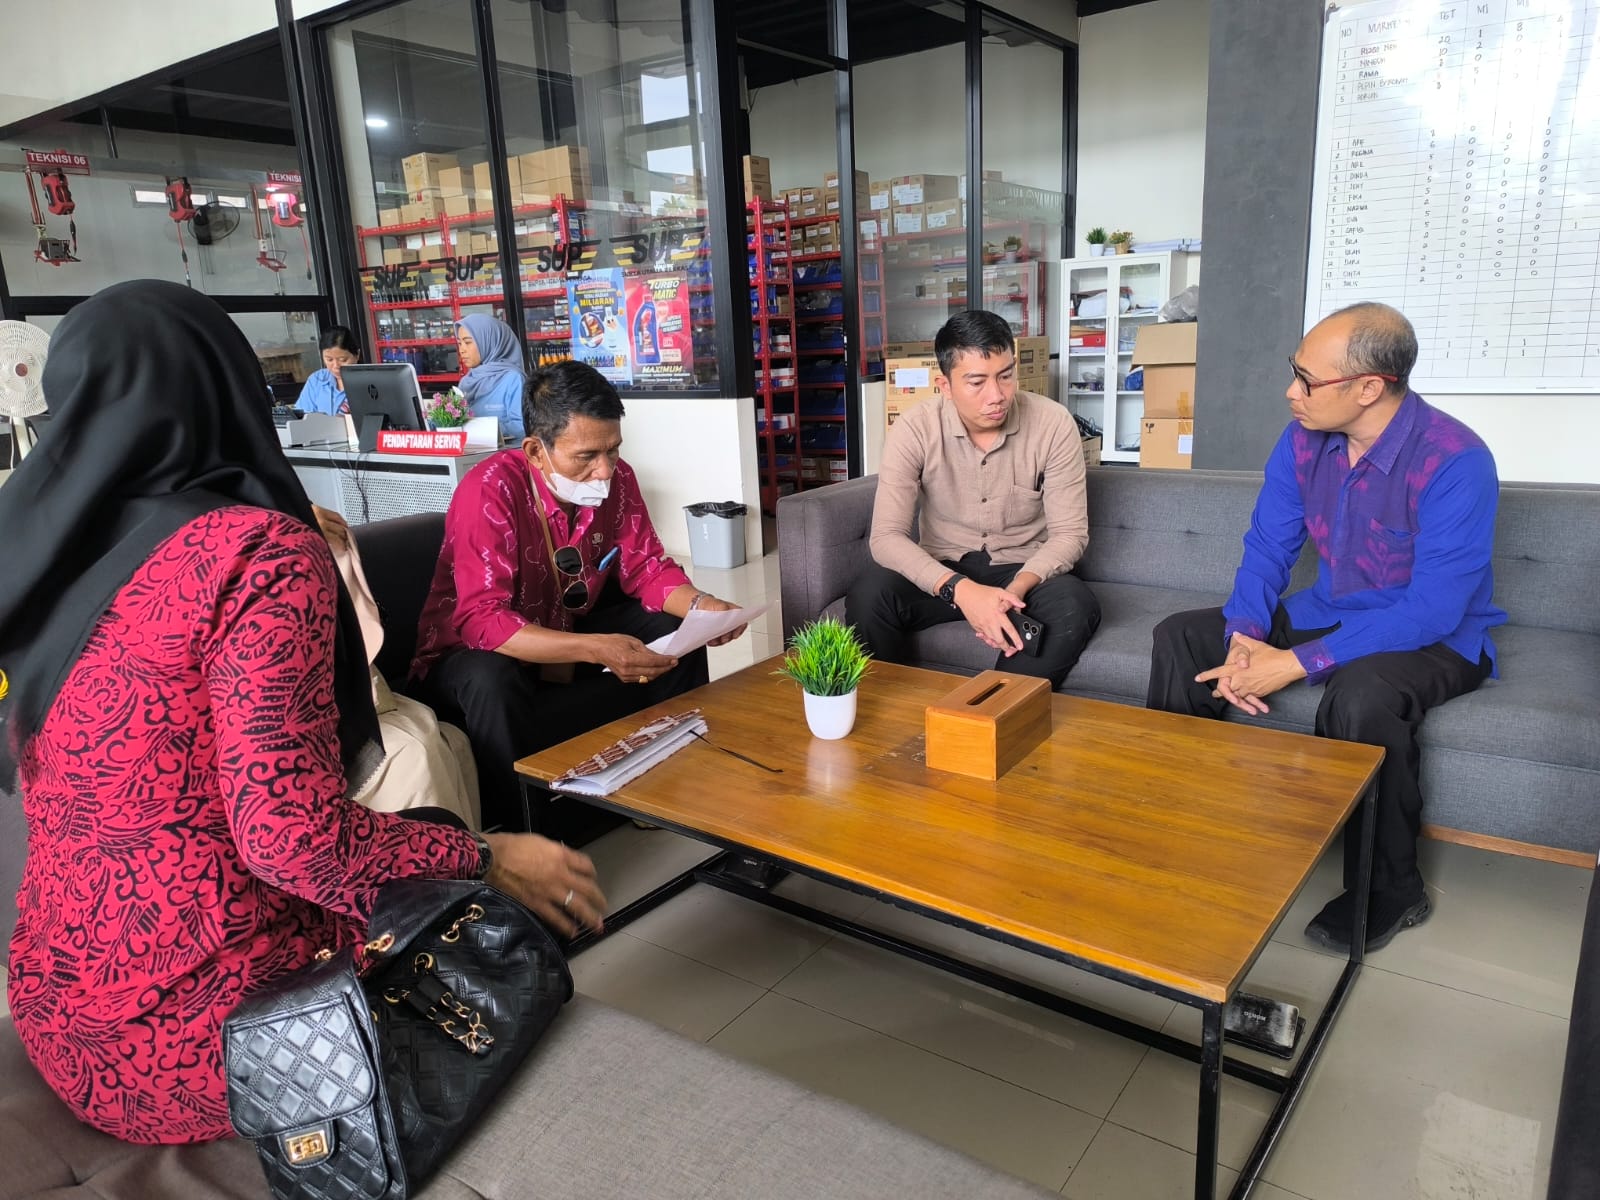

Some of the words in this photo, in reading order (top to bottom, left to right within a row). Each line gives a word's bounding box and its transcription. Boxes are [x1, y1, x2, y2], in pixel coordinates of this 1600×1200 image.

[1342, 28, 1352, 39] NO
[1438, 35, 1450, 44] 20
[1475, 54, 1482, 62] 0
[1506, 132, 1512, 140] 0
[1545, 128, 1552, 136] 0
[28, 152, 73, 164] TEKNISI
[1504, 157, 1511, 165] 0
[1540, 164, 1548, 172] 0
[270, 173, 302, 183] TEKNISI
[1425, 187, 1431, 195] 5
[537, 245, 583, 273] SUP
[445, 256, 483, 282] SUP
[373, 264, 410, 290] SUP
[647, 278, 680, 290] TURBO
[653, 289, 677, 301] MATIC
[580, 297, 615, 307] MILIARAN
[642, 365, 683, 374] MAXIMUM
[382, 434, 433, 449] PENDAFTARAN
[433, 434, 462, 449] SERVIS
